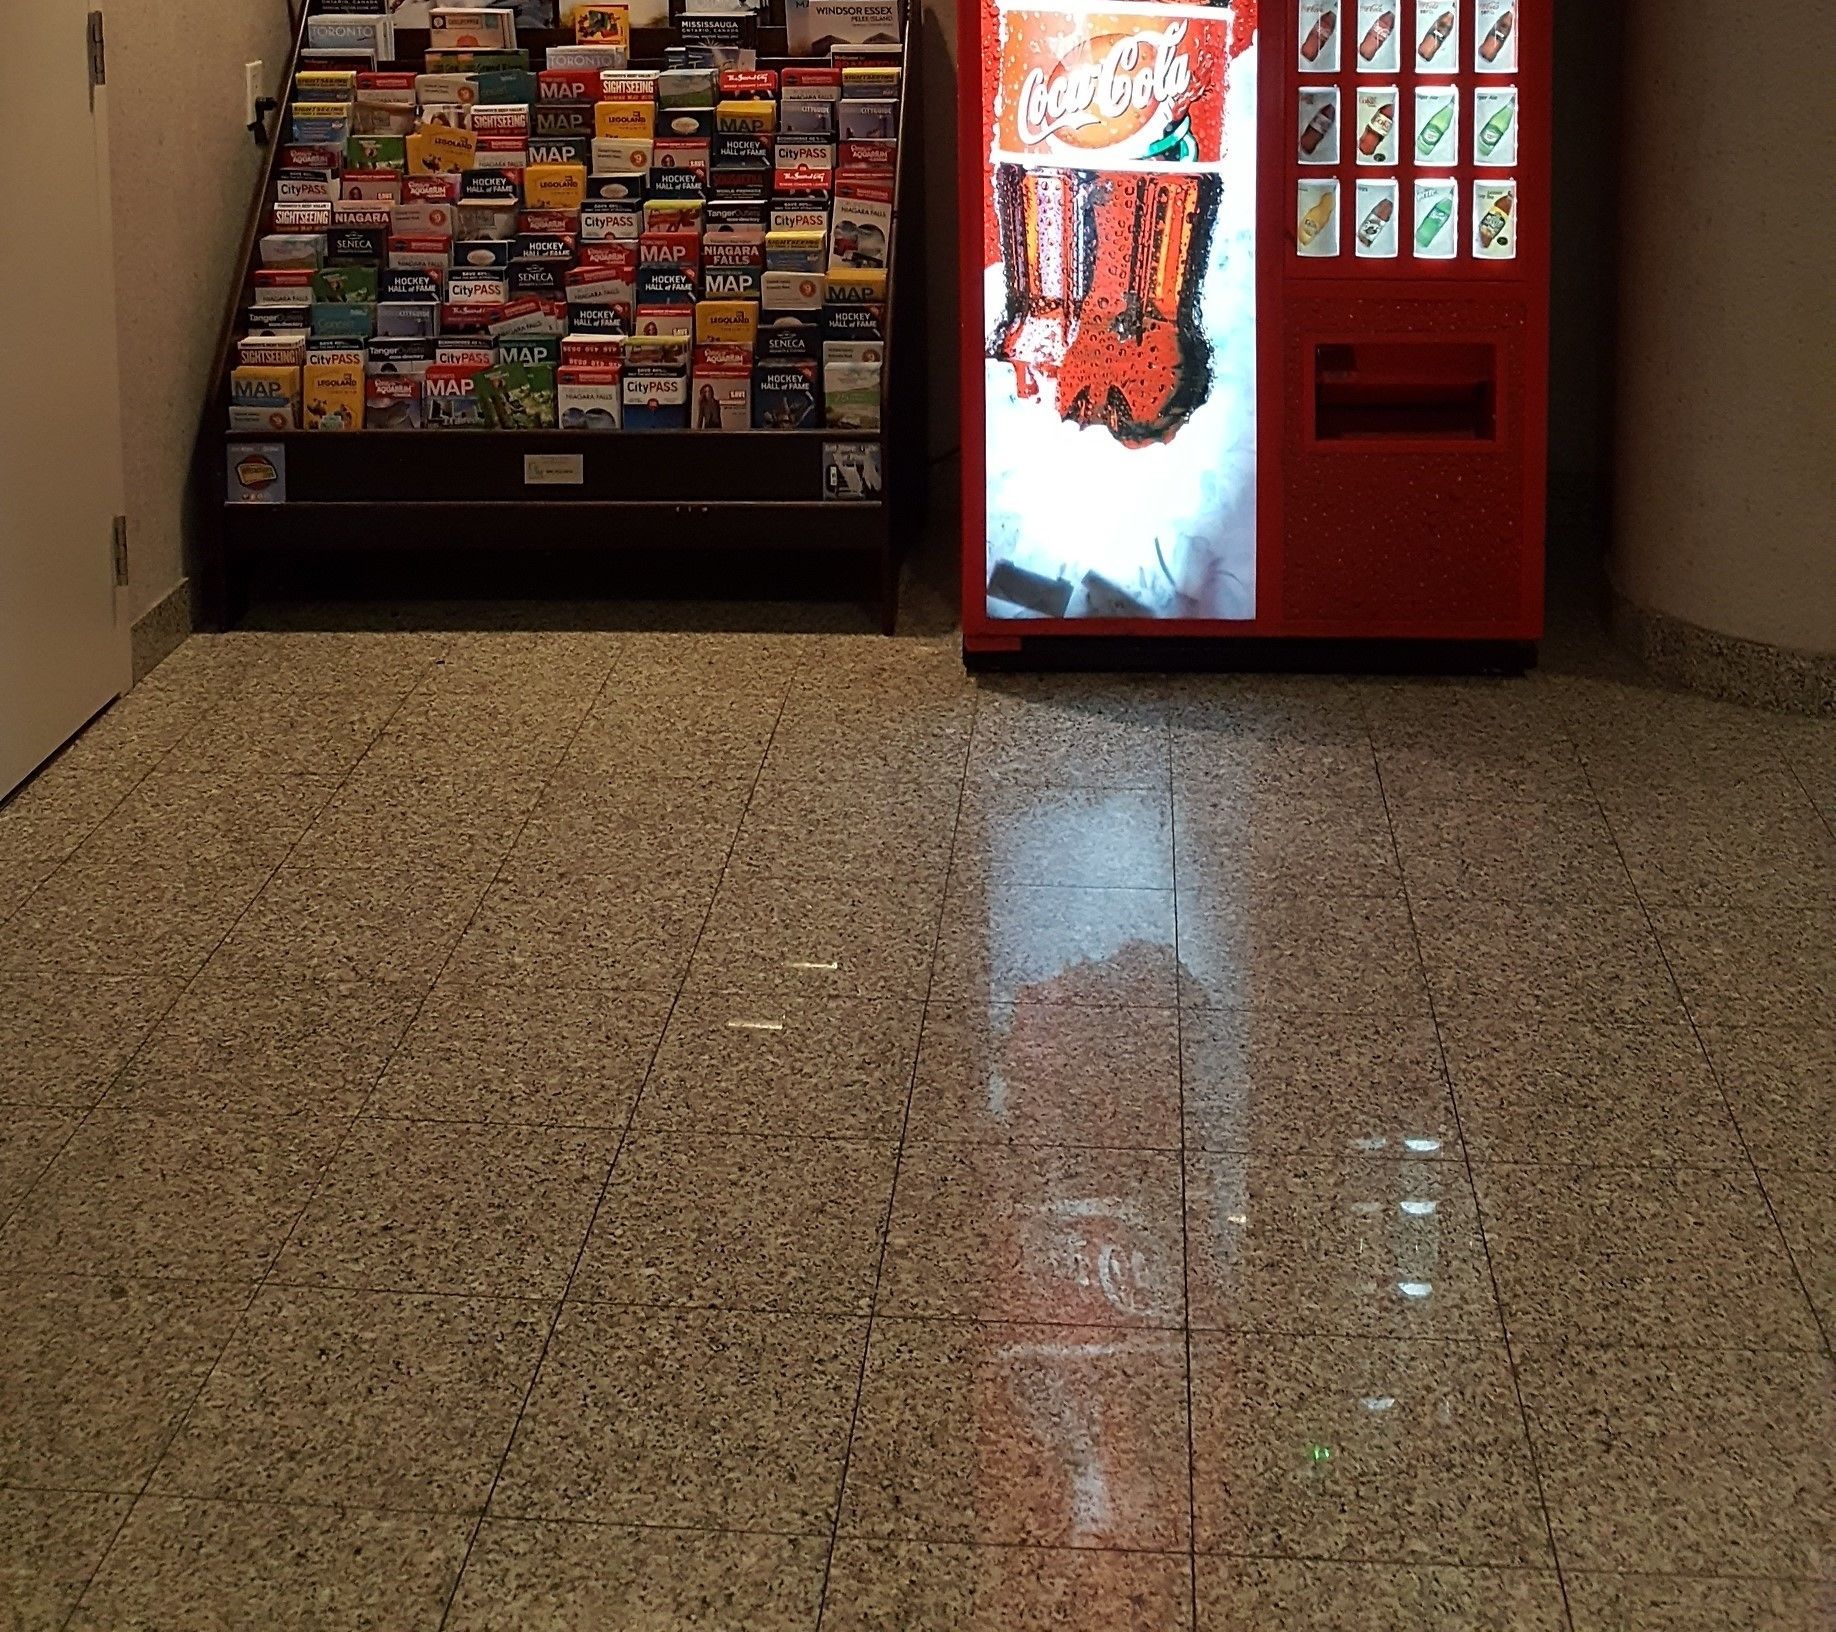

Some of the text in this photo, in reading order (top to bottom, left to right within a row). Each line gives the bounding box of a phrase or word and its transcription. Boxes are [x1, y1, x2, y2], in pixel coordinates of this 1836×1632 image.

[816, 6, 893, 15] WINDSOR ESSEX
[681, 20, 739, 28] MISSISSAUGA
[311, 26, 374, 37] TORONTO
[549, 55, 613, 66] TORONTO
[540, 82, 585, 99] MAP
[602, 80, 654, 94] SIGHTSEEING
[474, 115, 527, 128] SIGHTSEEING
[537, 114, 583, 130] MAP
[720, 118, 764, 132] MAP
[434, 137, 473, 150] LEGOLAND
[726, 140, 760, 148] HOCKEY
[529, 146, 576, 163] MAP
[747, 148, 767, 156] FAME
[778, 148, 827, 161] CityPASS
[472, 178, 507, 186] HOCKEY
[540, 180, 578, 188] LEGOLAND
[681, 182, 702, 190] FAME
[281, 184, 328, 196] CityPASS
[493, 185, 513, 193] FAME
[841, 206, 870, 216] NIAGARA
[275, 210, 329, 225] SIGHTSEEING
[335, 211, 389, 224] NIAGARA
[585, 216, 634, 229] CityPASS
[774, 214, 824, 228] CityPASS
[337, 240, 372, 249] SENECA
[529, 242, 564, 250] HOCKEY
[550, 249, 570, 257] FAME
[640, 246, 686, 262] MAP
[703, 246, 759, 256] NIAGARA
[713, 256, 751, 265] FALLS
[394, 276, 430, 285] HOCKEY
[518, 272, 554, 282] SENECA
[651, 275, 687, 284] HOCKEY
[387, 285, 407, 293] HALL
[415, 284, 436, 293] FAME
[645, 283, 664, 291] HALL
[672, 283, 693, 291] FAME
[705, 275, 753, 292] MAP
[452, 284, 501, 298] CityPASS
[828, 286, 875, 301] MAP
[580, 310, 615, 318] HOCKEY
[710, 314, 750, 324] LEGOLAND
[573, 318, 592, 326] HALL
[600, 318, 621, 326] FAME
[856, 319, 877, 327] FAME
[769, 338, 805, 348] SENECA
[309, 353, 361, 365] CityPASS
[439, 352, 490, 364] CityPASS
[499, 347, 548, 365] MAP
[317, 378, 357, 387] LEGOLAND
[767, 374, 803, 383] HOCKEY
[234, 381, 281, 398] MAP
[426, 379, 475, 396] MAP
[627, 381, 678, 394] CityPASS
[761, 382, 780, 390] HALL
[788, 382, 810, 390] FAME
